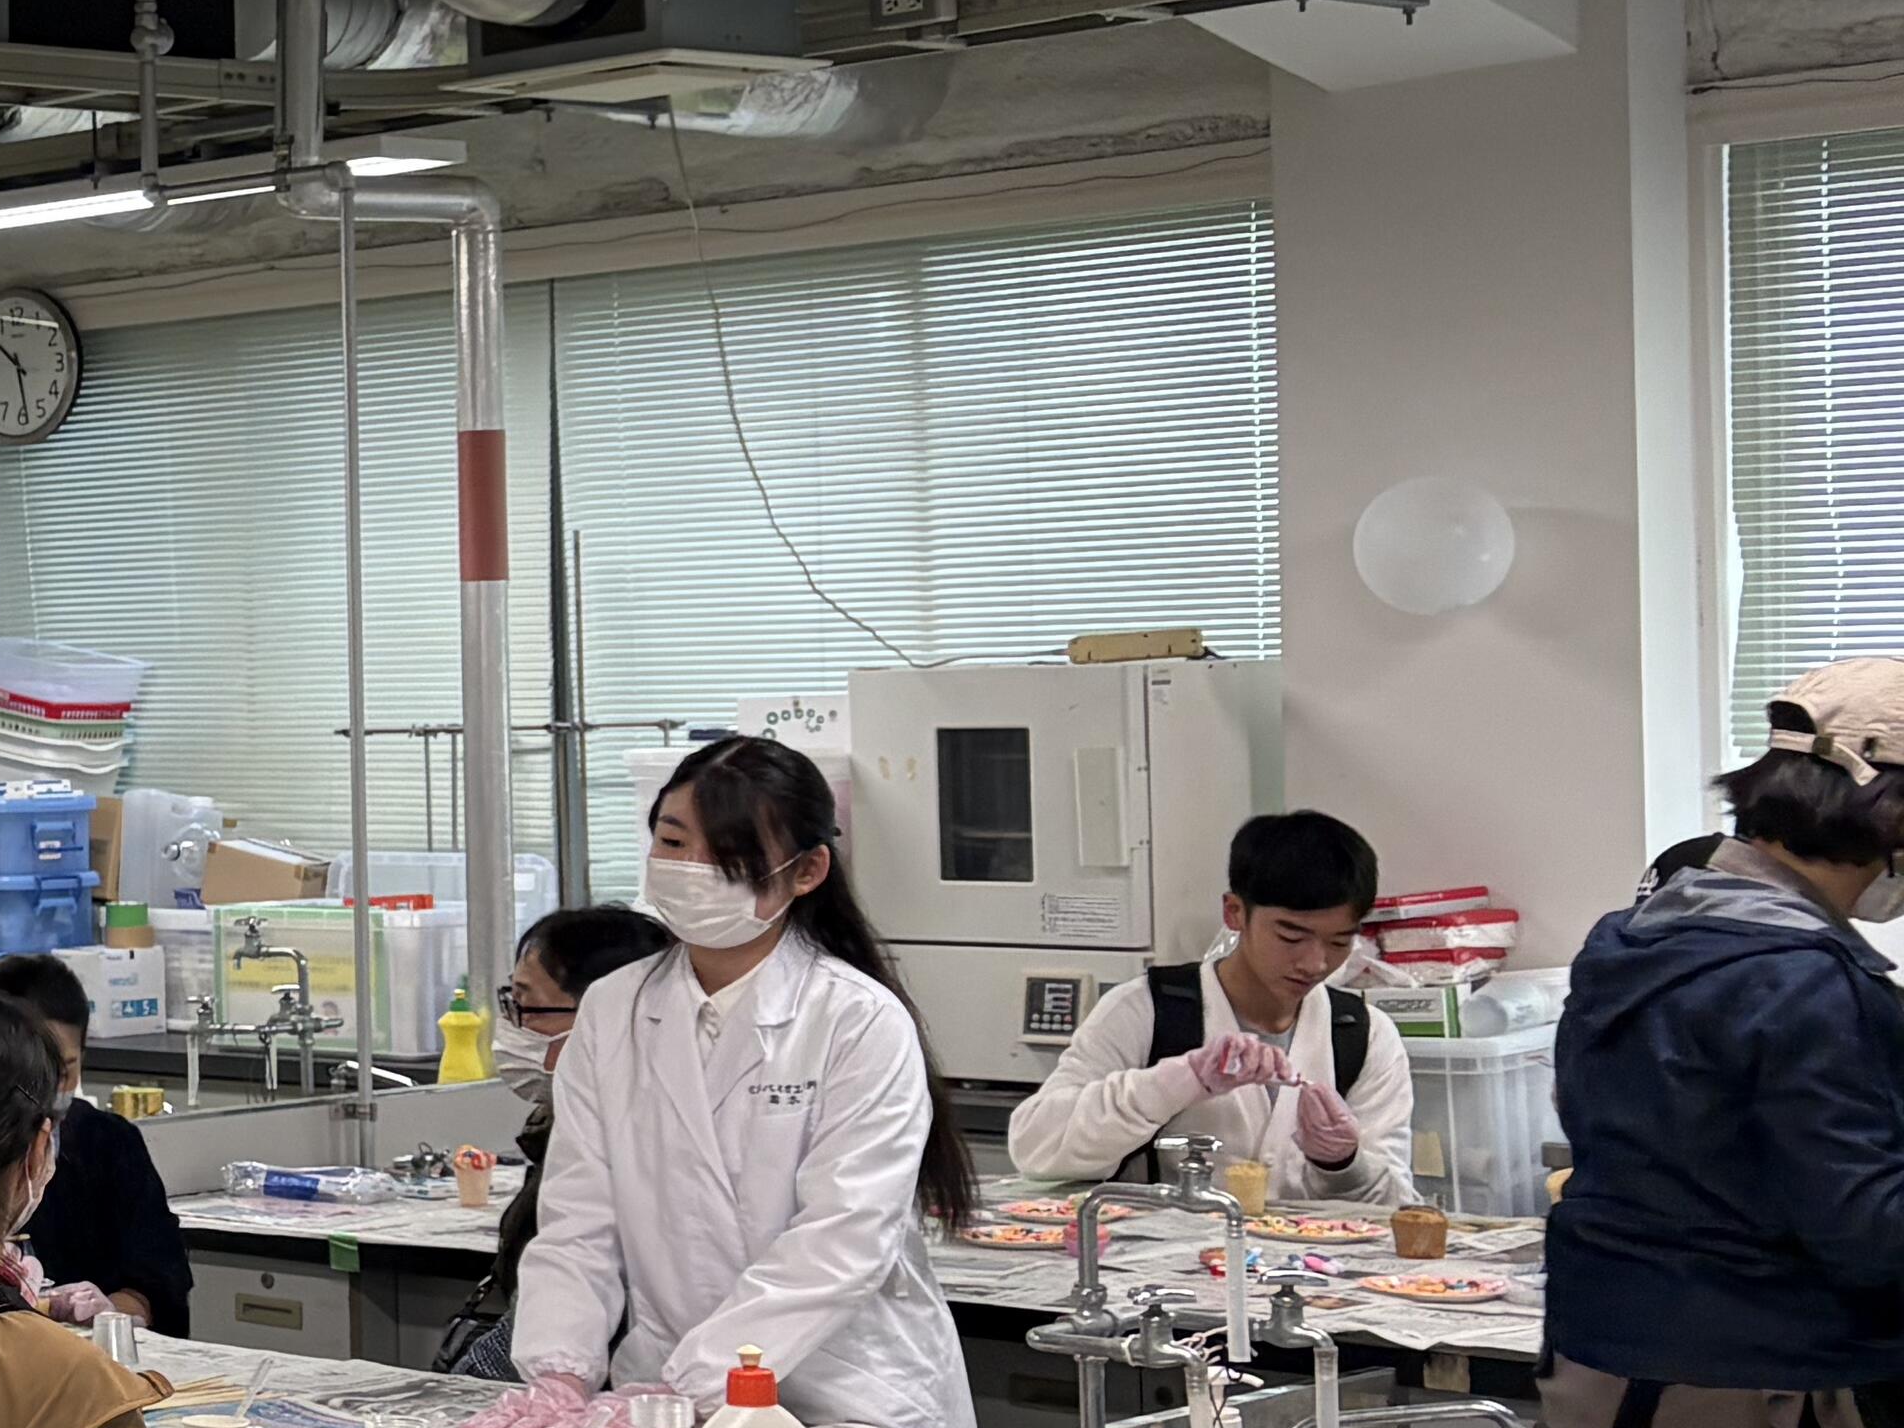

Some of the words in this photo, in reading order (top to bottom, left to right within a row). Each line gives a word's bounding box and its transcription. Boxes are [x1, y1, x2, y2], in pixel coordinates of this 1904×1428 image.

[10, 307, 25, 326] 12
[35, 311, 41, 330] 1
[47, 328, 57, 347] 2
[55, 353, 65, 372] 3
[49, 380, 59, 399] 4
[0, 402, 9, 421] 7
[17, 406, 29, 425] 6
[36, 399, 46, 418] 5
